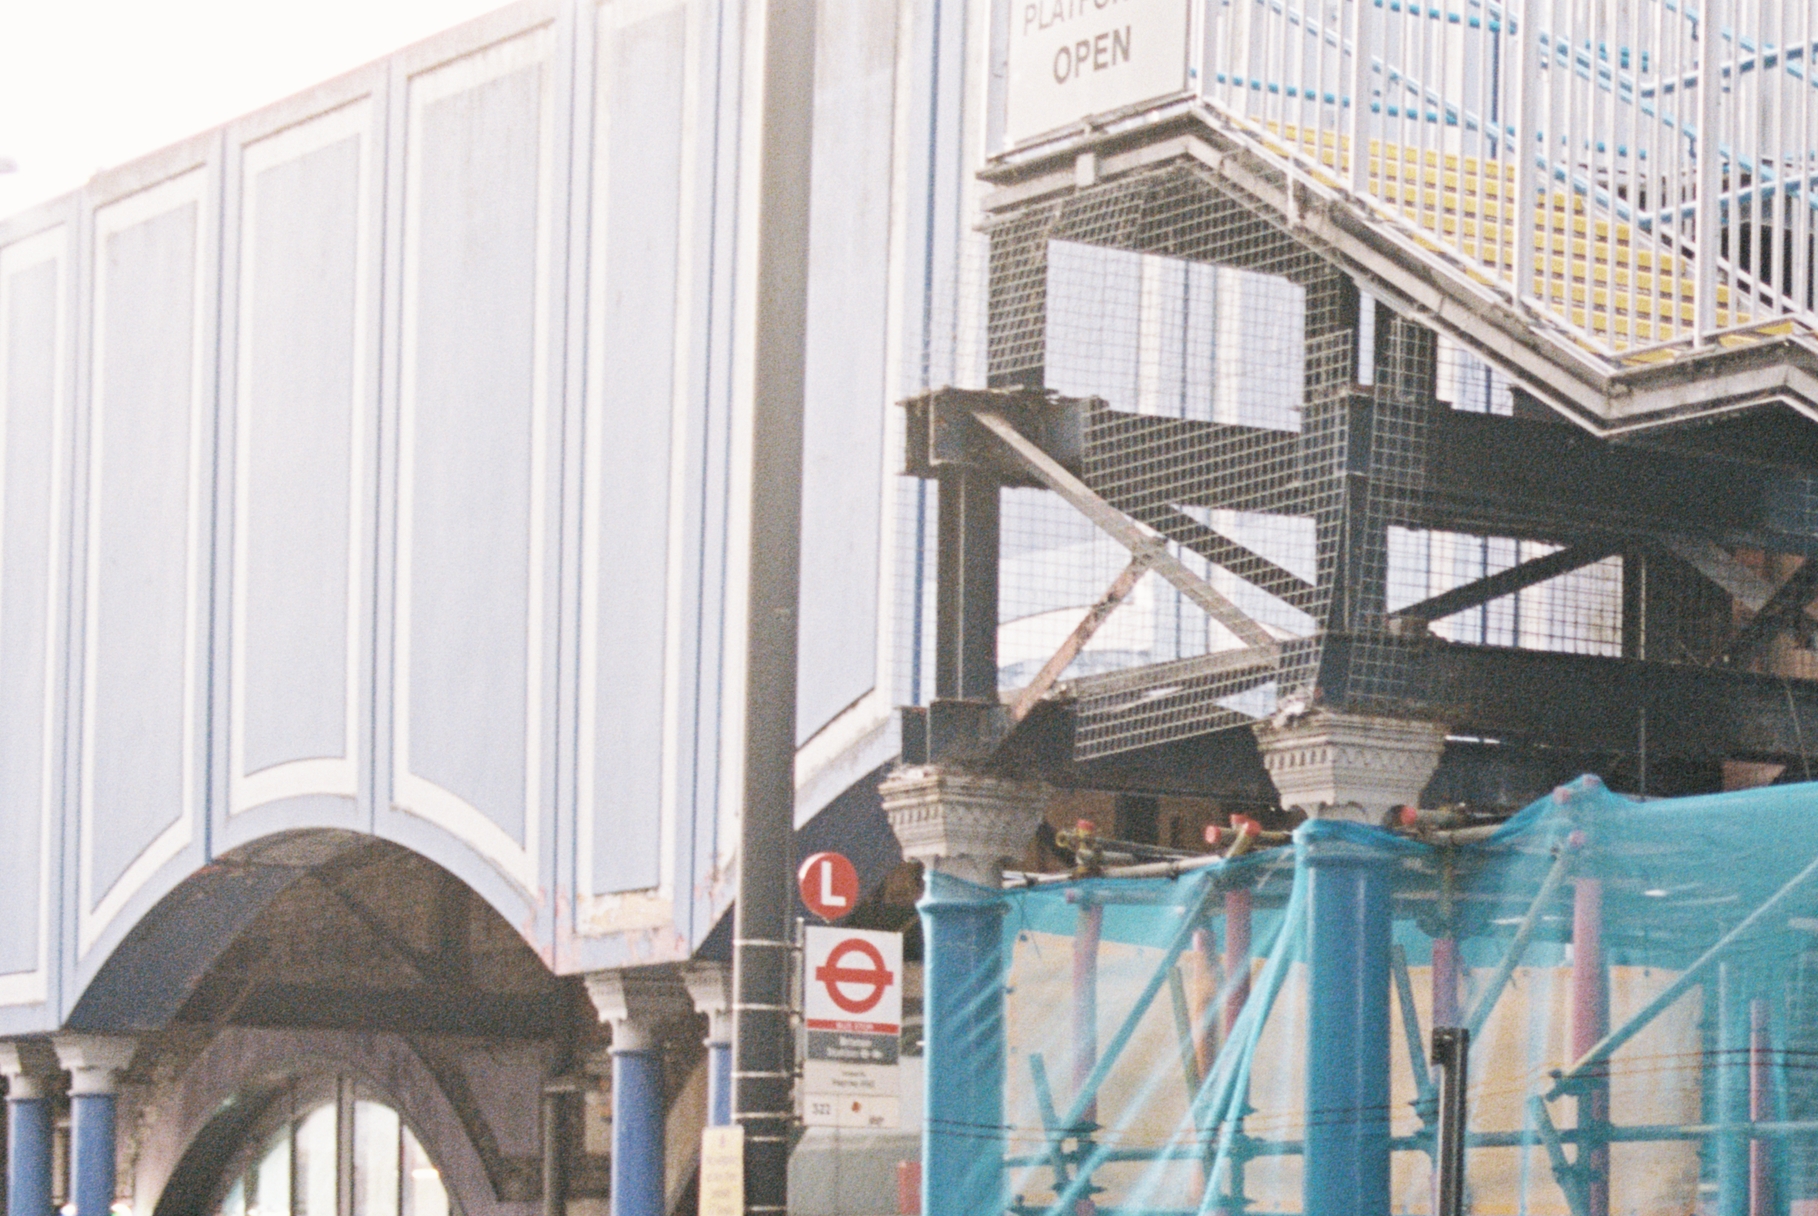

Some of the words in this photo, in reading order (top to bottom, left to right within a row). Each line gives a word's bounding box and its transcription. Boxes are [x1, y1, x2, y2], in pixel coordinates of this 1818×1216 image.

[1023, 0, 1120, 36] PLAT
[1053, 25, 1131, 85] OPEN
[820, 861, 847, 907] L
